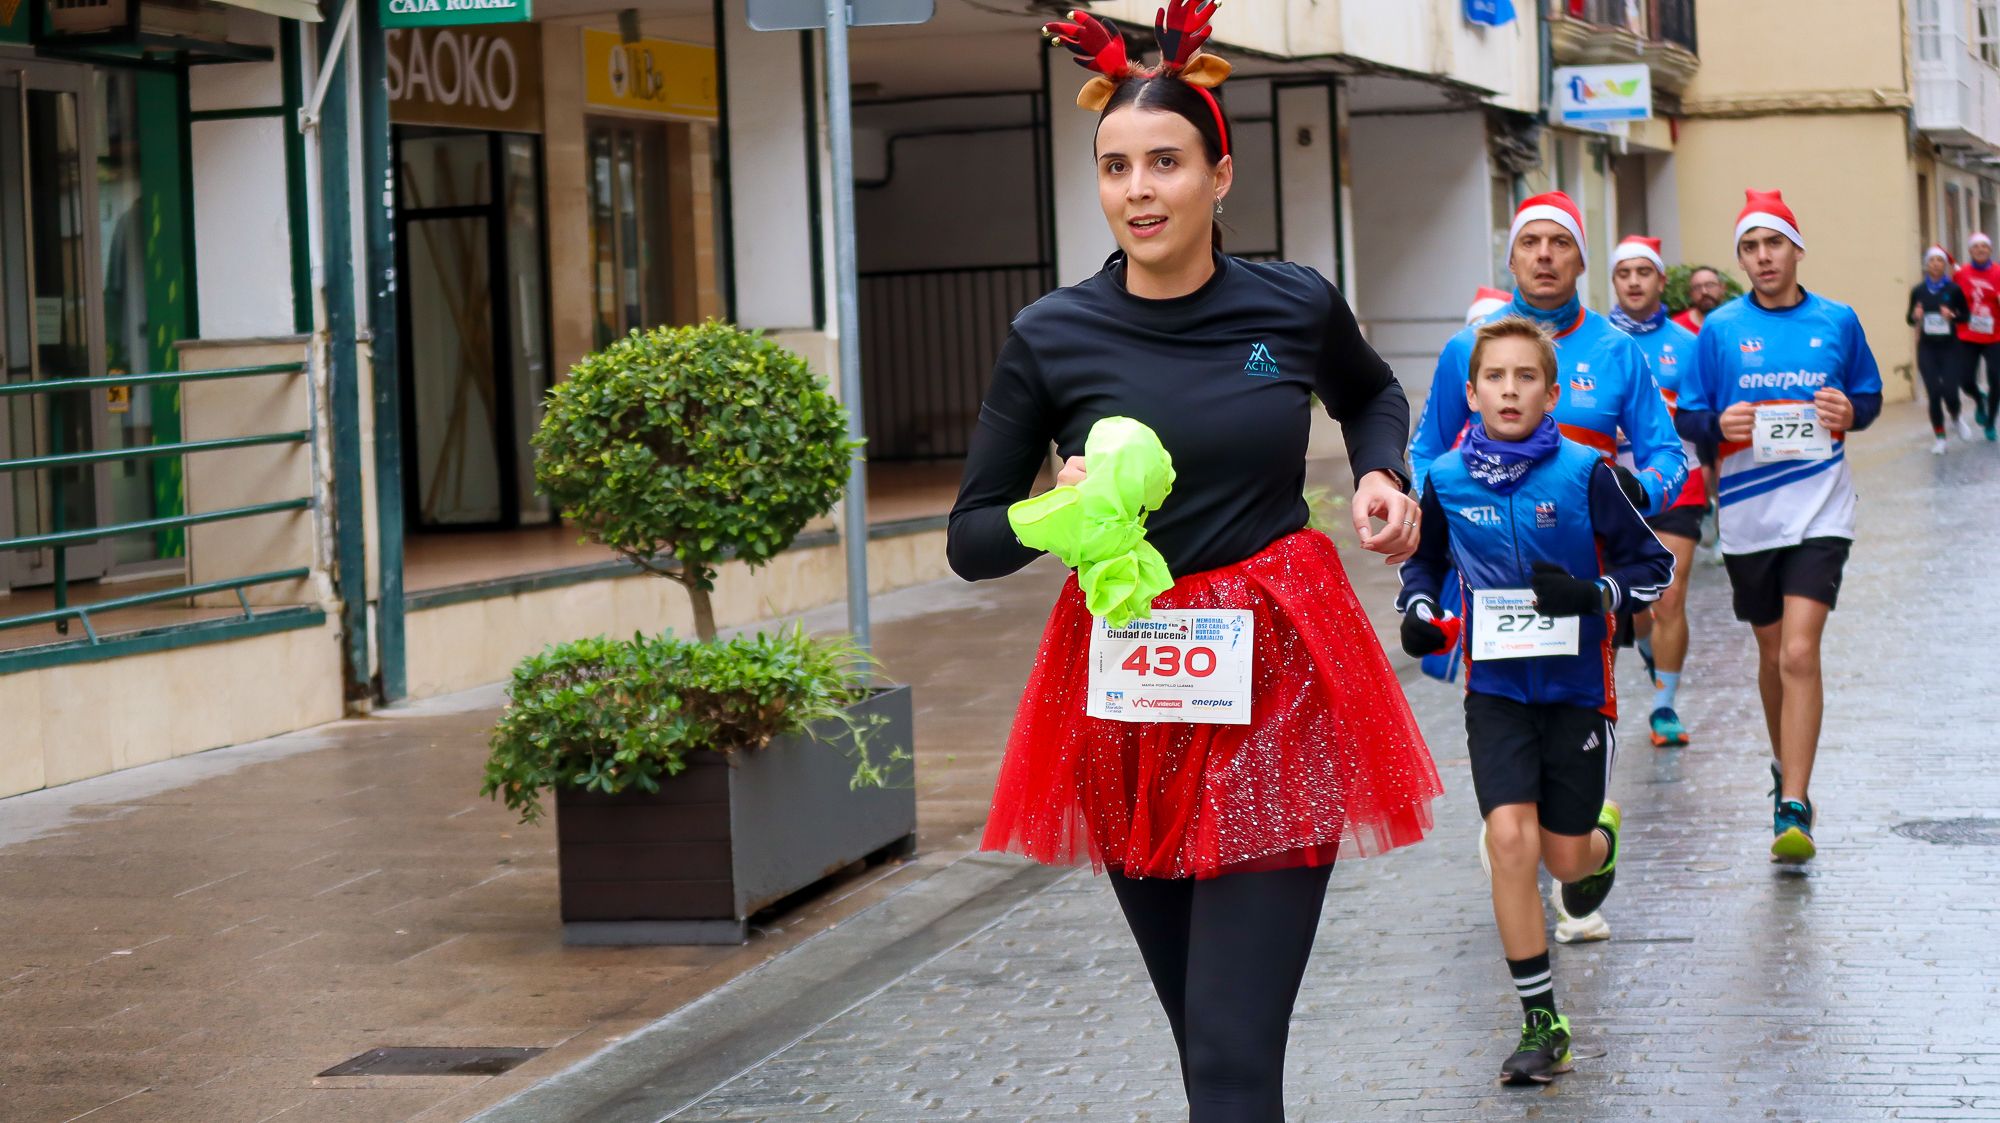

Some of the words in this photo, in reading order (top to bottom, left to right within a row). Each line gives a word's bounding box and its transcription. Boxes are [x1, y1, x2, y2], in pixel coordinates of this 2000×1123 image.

[385, 28, 518, 112] SAOKO
[1244, 361, 1280, 374] ACTIVA
[1739, 369, 1828, 391] enerplus
[1771, 423, 1814, 440] 272
[1127, 619, 1168, 630] Silvestre
[1497, 615, 1554, 632] 273
[1107, 630, 1140, 639] Ciudad
[1141, 631, 1149, 639] de
[1154, 631, 1187, 640] Lucena
[1121, 645, 1217, 677] 430
[1191, 698, 1233, 708] enerplus
